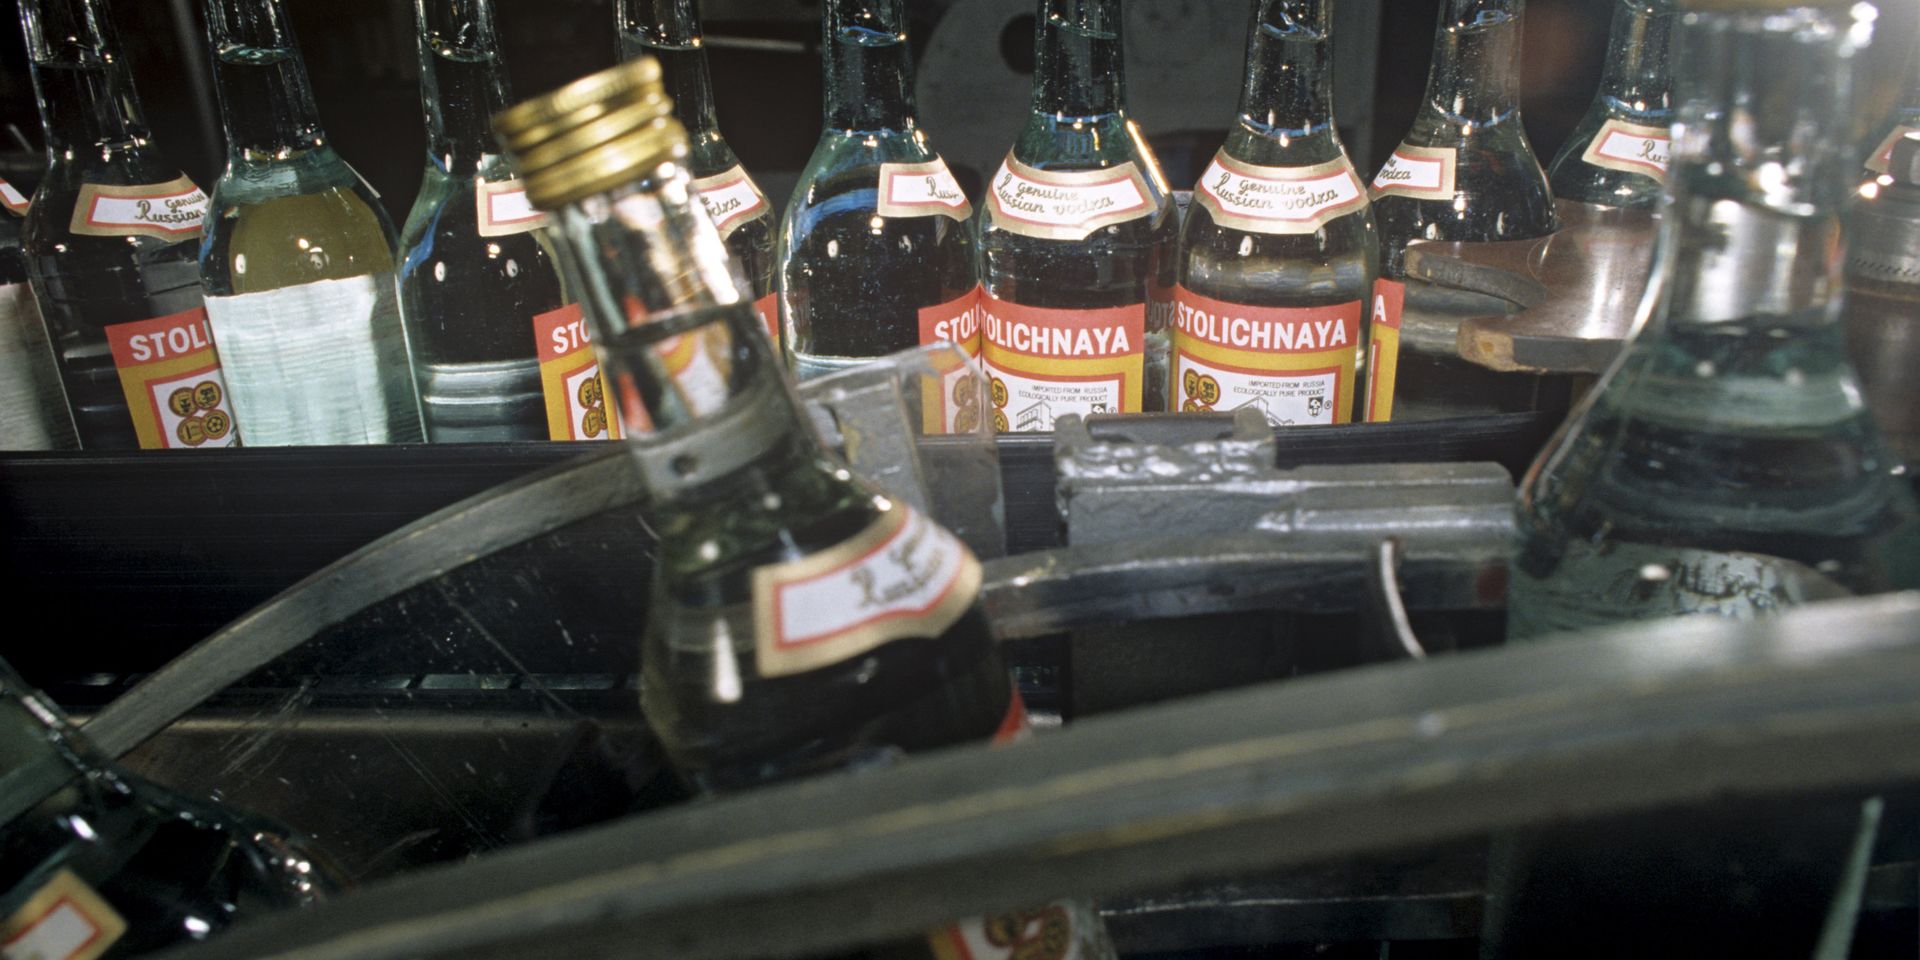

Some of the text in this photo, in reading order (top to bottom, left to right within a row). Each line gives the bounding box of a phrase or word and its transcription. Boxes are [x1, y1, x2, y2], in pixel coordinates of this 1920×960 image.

[981, 304, 1130, 355] TOLICHNAYA
[1177, 300, 1347, 350] STOLICHNAYA
[1032, 385, 1107, 394] IMPORTED FROM RUSSIA
[1249, 380, 1281, 388] IMPORTED
[1303, 380, 1325, 388] RUSSIA
[1018, 390, 1108, 402] ECOLOGICALLY PURE PRODUCT
[1233, 386, 1277, 397] ECOLOGICALLY
[1298, 388, 1325, 397] PRODUCT
